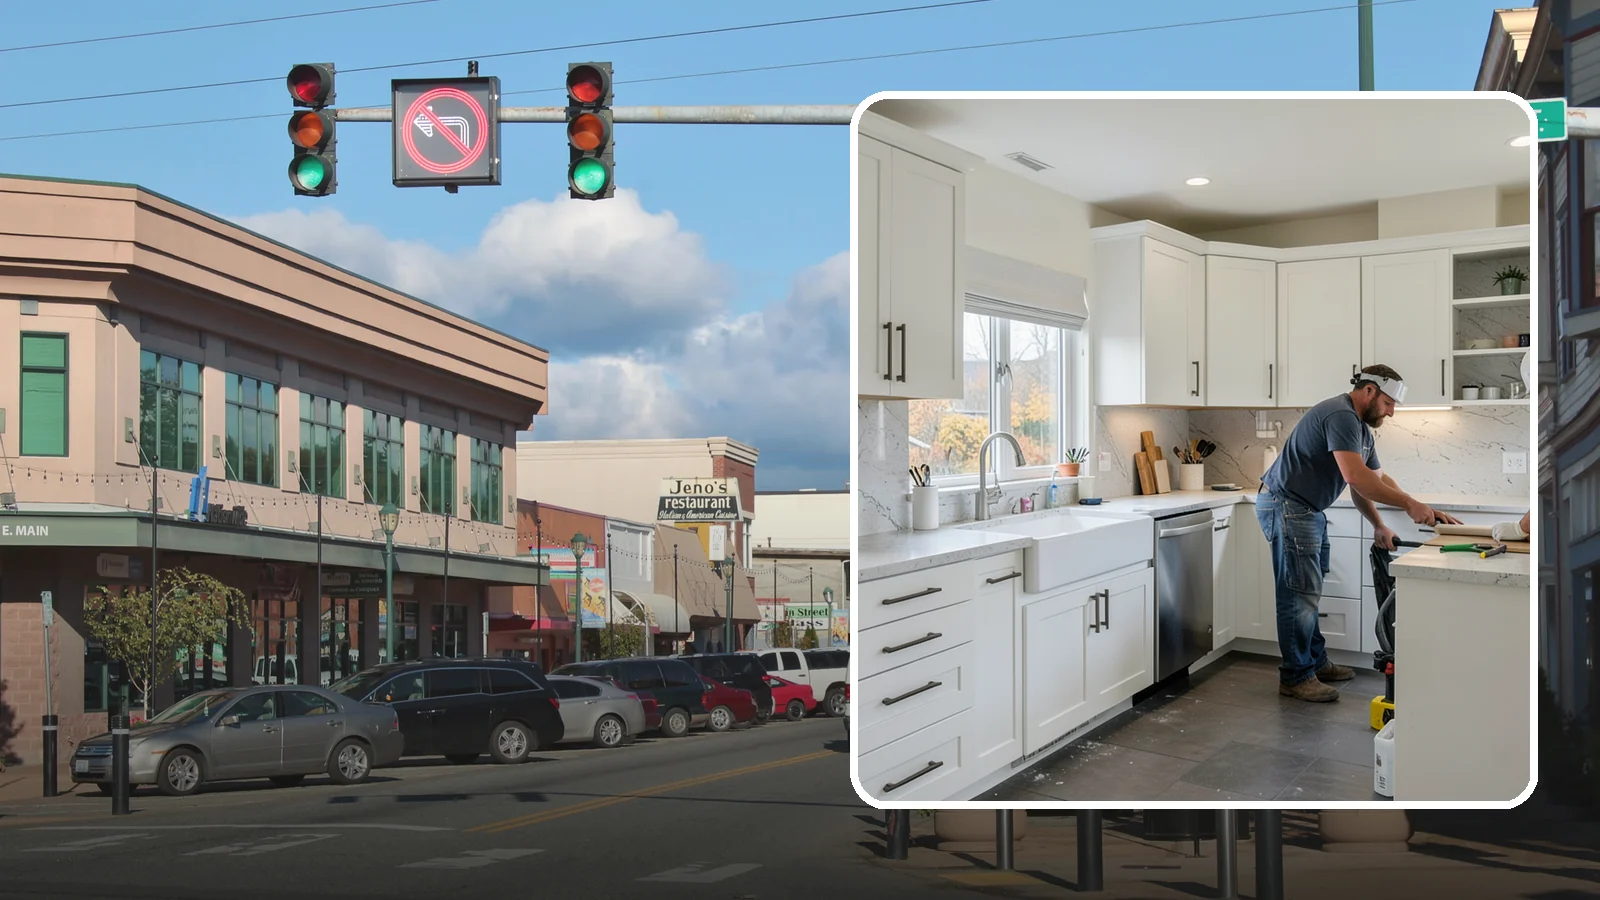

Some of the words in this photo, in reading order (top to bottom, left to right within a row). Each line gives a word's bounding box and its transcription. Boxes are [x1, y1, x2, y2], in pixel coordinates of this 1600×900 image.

[669, 480, 728, 494] Jeno's
[665, 496, 731, 509] restaurant
[659, 510, 682, 519] Italian
[686, 510, 714, 519] American
[715, 510, 737, 519] Cuisine
[2, 525, 13, 536] E.
[15, 525, 49, 536] MAIN
[797, 607, 829, 617] Street
[791, 619, 824, 627] lass
